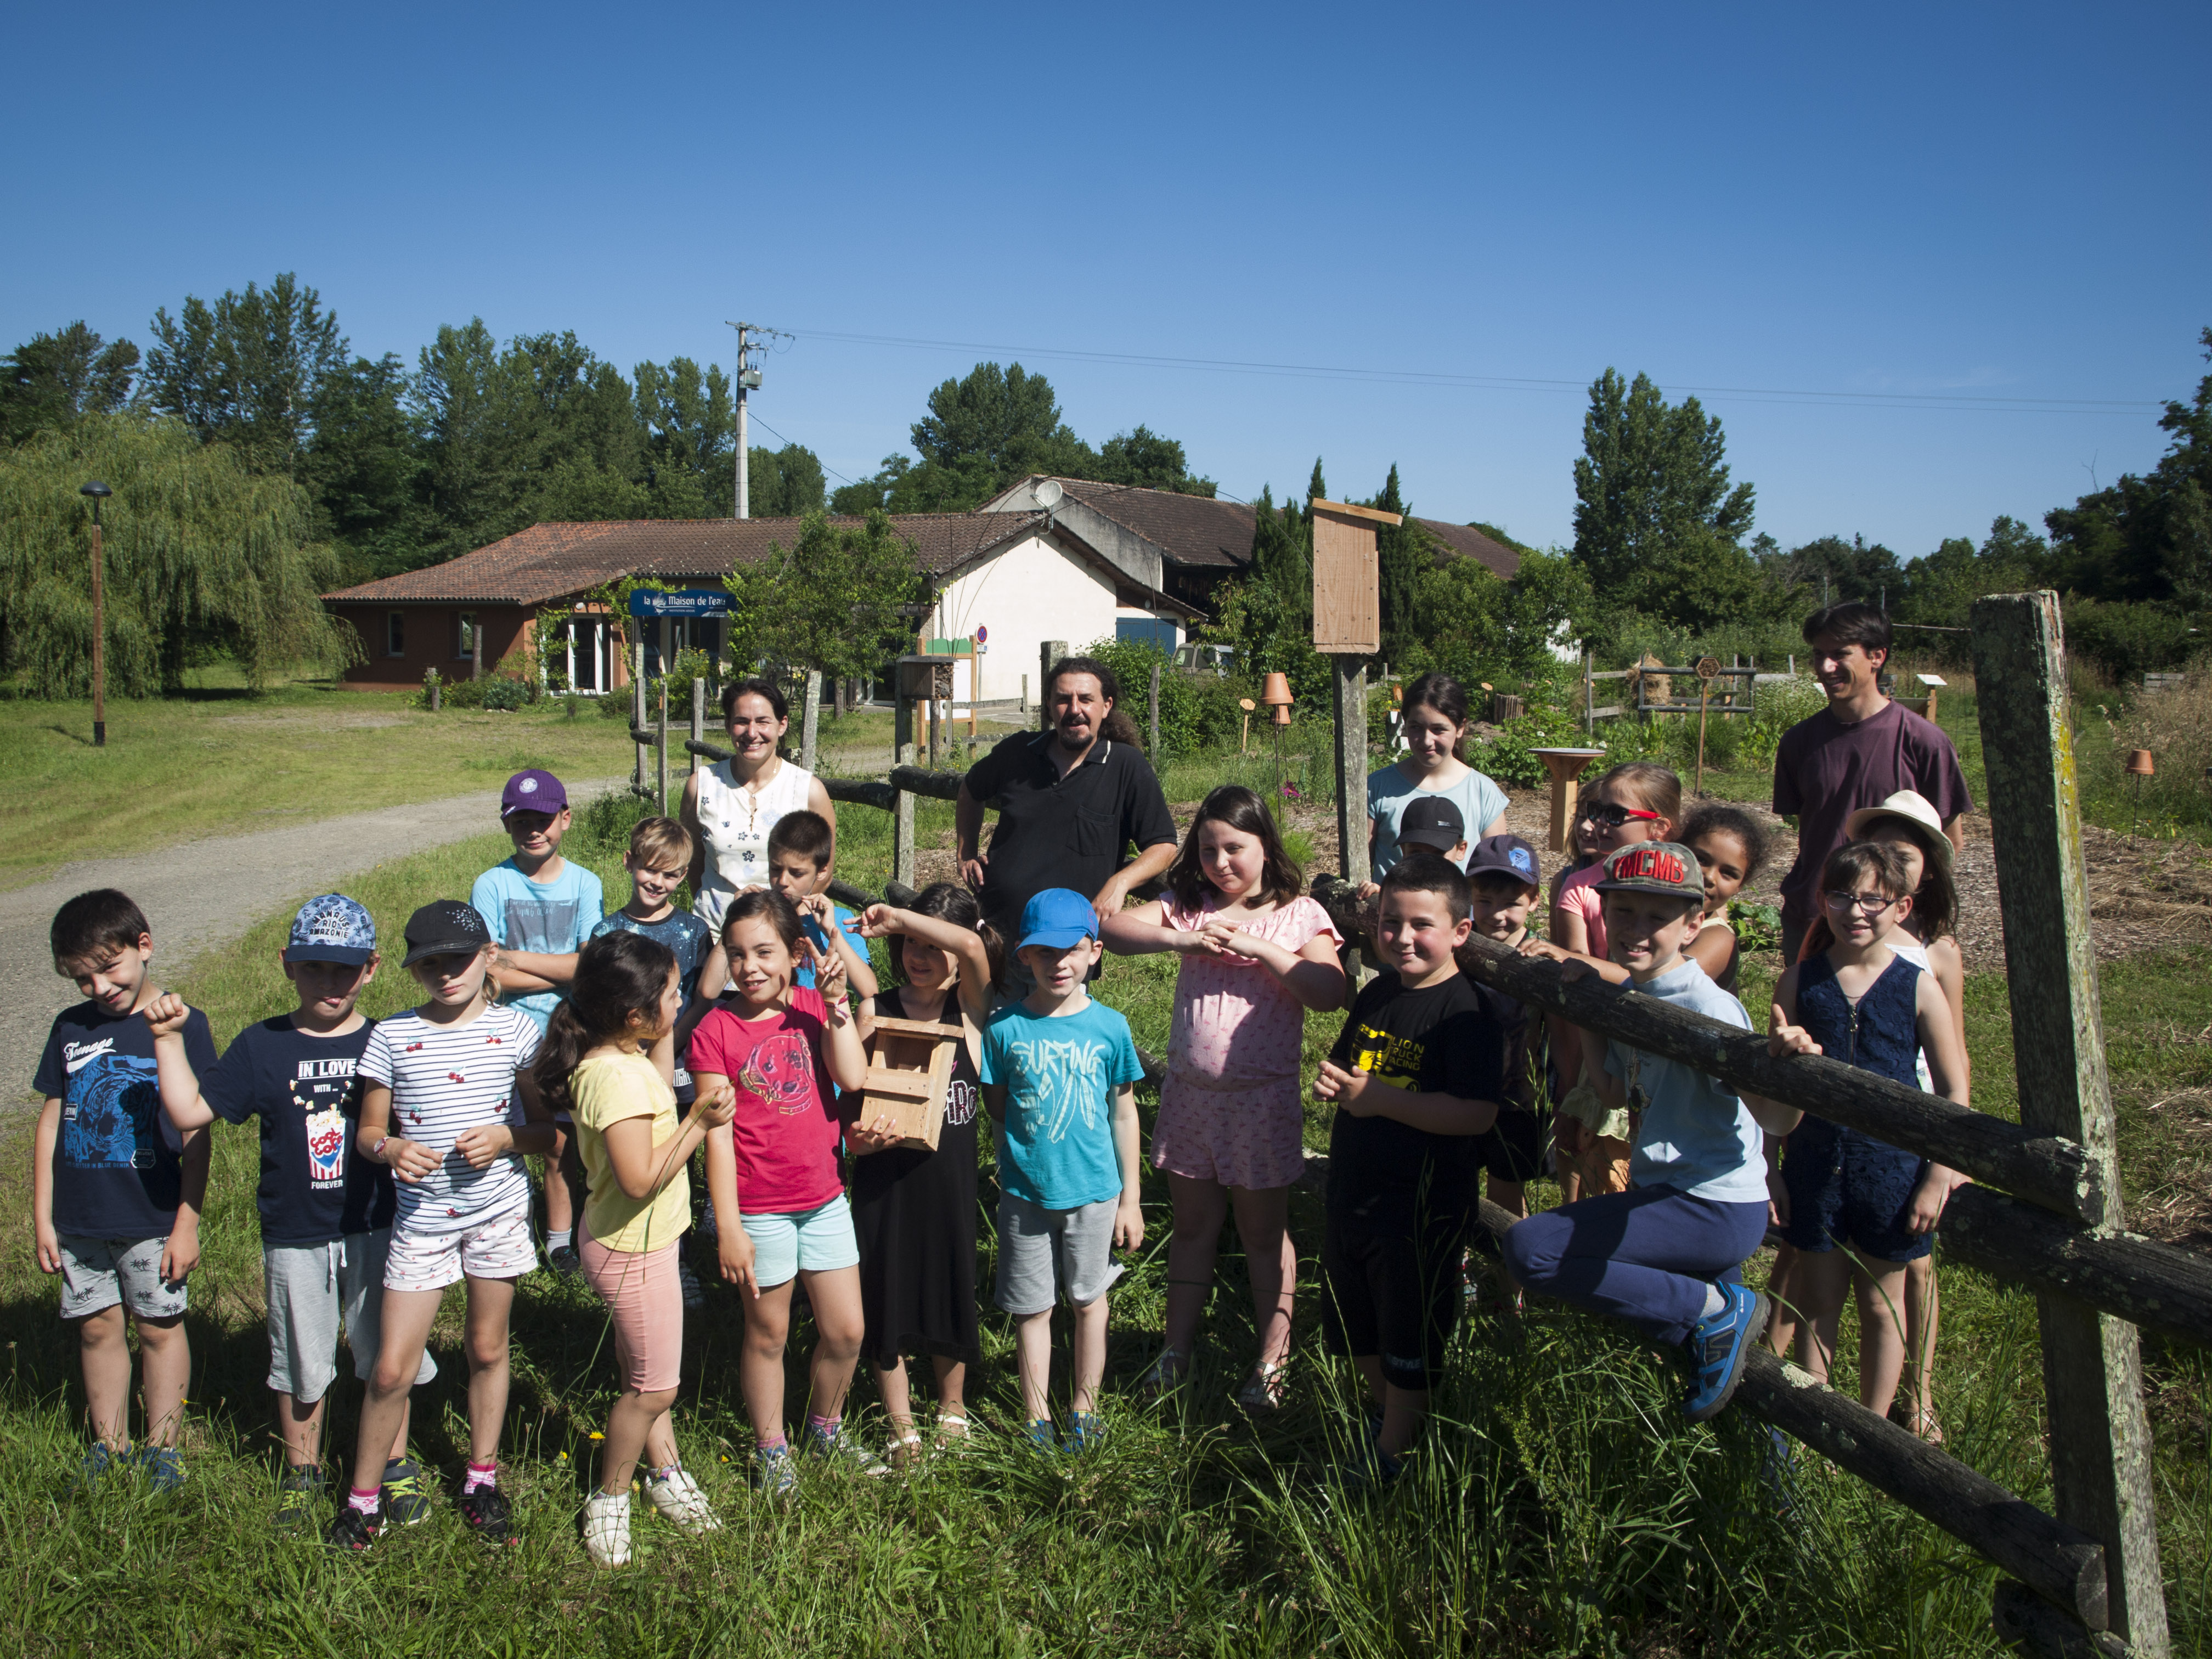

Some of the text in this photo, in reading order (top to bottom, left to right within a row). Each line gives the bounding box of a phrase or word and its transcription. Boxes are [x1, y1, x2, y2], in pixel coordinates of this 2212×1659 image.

[644, 596, 725, 605] la Maison de l'eau
[1613, 850, 1684, 883] YMCMB
[312, 910, 349, 927] MANAUS
[309, 928, 348, 938] AMAZONIE
[1392, 1036, 1425, 1053] LION
[298, 1060, 356, 1077] IN LOVE
[1011, 1039, 1105, 1087] SURFING
[313, 1084, 331, 1093] WITH
[311, 1180, 343, 1189] FOREVER
